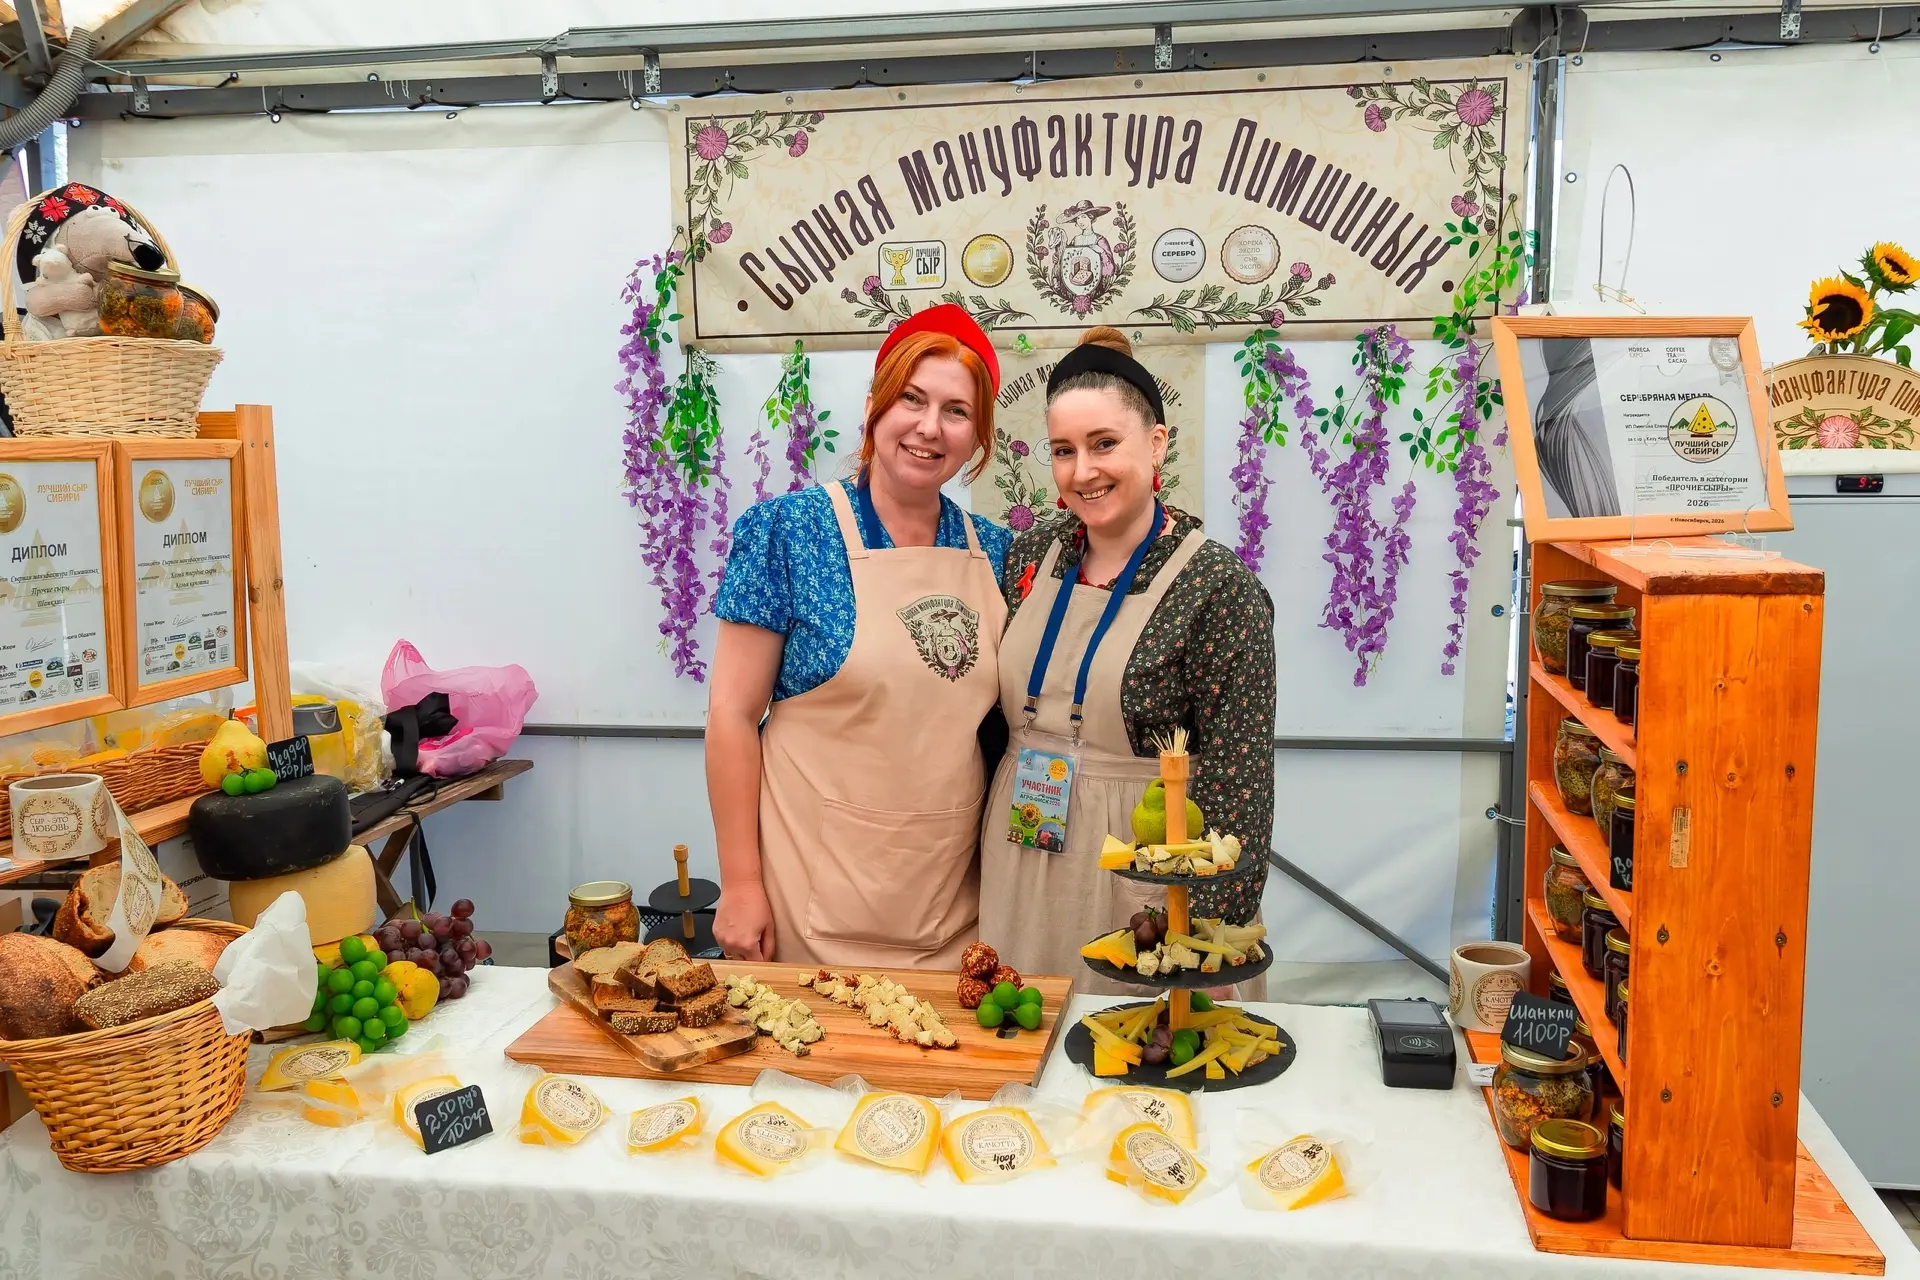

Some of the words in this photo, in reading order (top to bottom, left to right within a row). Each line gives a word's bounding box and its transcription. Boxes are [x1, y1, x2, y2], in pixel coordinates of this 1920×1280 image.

[738, 173, 896, 312] Сырная
[898, 112, 1203, 216] мануфактура
[1217, 117, 1452, 294] Пимшиных
[915, 246, 941, 257] ЛУЧШИЙ
[916, 256, 941, 275] СЫР
[1674, 440, 1710, 448] ЛУЧШИЙ
[1711, 440, 1729, 448] СЫР
[1683, 447, 1719, 455] СИБИРИ
[184, 477, 211, 488] ЛУЧШИЙ
[212, 478, 224, 486] СЫР
[1652, 474, 1699, 482] Победитель
[1706, 476, 1748, 484] категории
[37, 482, 71, 493] ЛУЧШИЙ
[72, 483, 88, 493] СЫР
[191, 487, 218, 496] СИБИРИ
[47, 493, 80, 502] СИБИРИ
[1687, 499, 1709, 507] 2026
[163, 531, 207, 548] ДИПЛОМ
[12, 543, 67, 563] ДИПЛОМ
[268, 737, 307, 768] Чеддер
[1021, 779, 1062, 796] УЧАСТНИК
[32, 823, 70, 833] ЛЮБОВЬ
[1485, 995, 1514, 1004] КАЧОТТ
[1509, 1004, 1574, 1021] Шанкли
[977, 1141, 1016, 1149] КАЧОТТА
